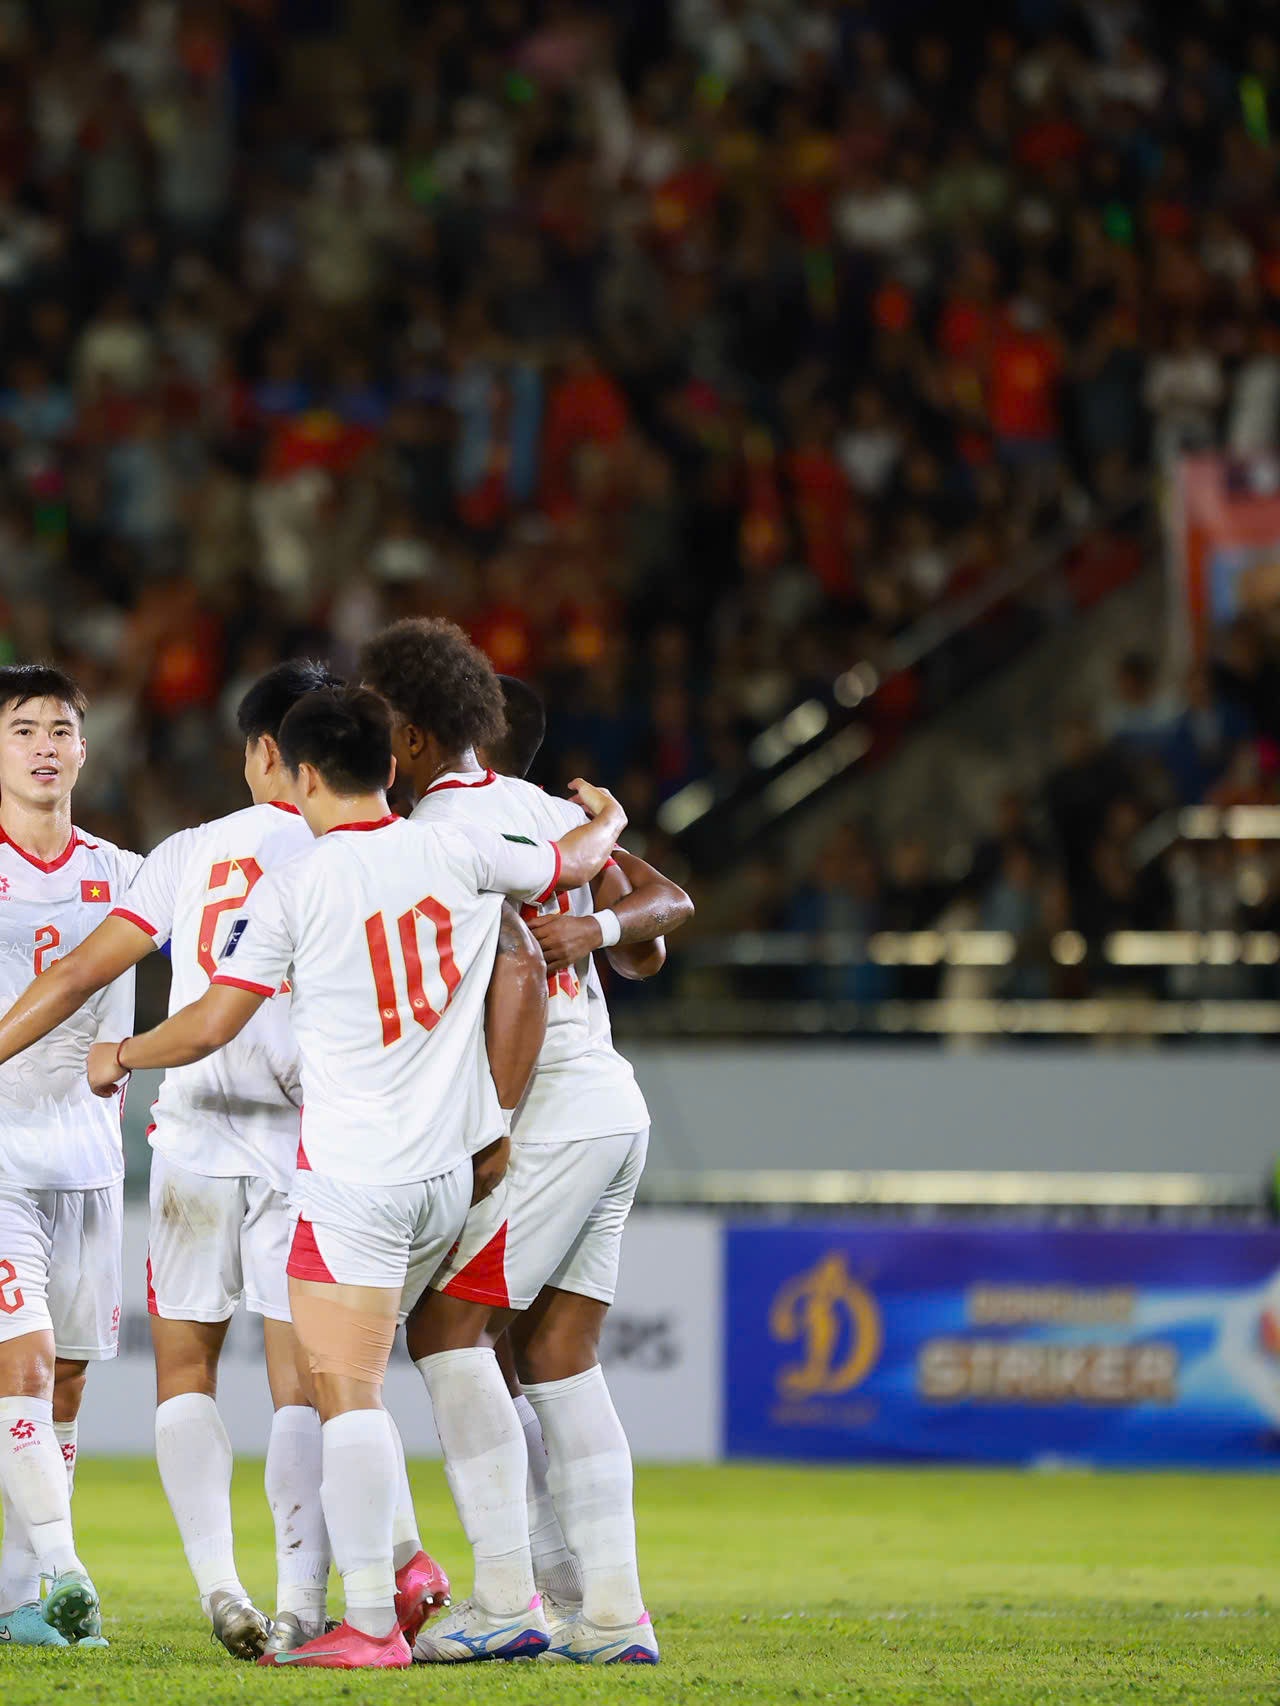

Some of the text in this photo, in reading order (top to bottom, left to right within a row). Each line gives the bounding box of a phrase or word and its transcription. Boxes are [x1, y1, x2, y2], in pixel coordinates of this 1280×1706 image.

[34, 924, 61, 978] 2
[365, 895, 462, 1047] 10
[918, 1339, 1178, 1404] STRIKER
